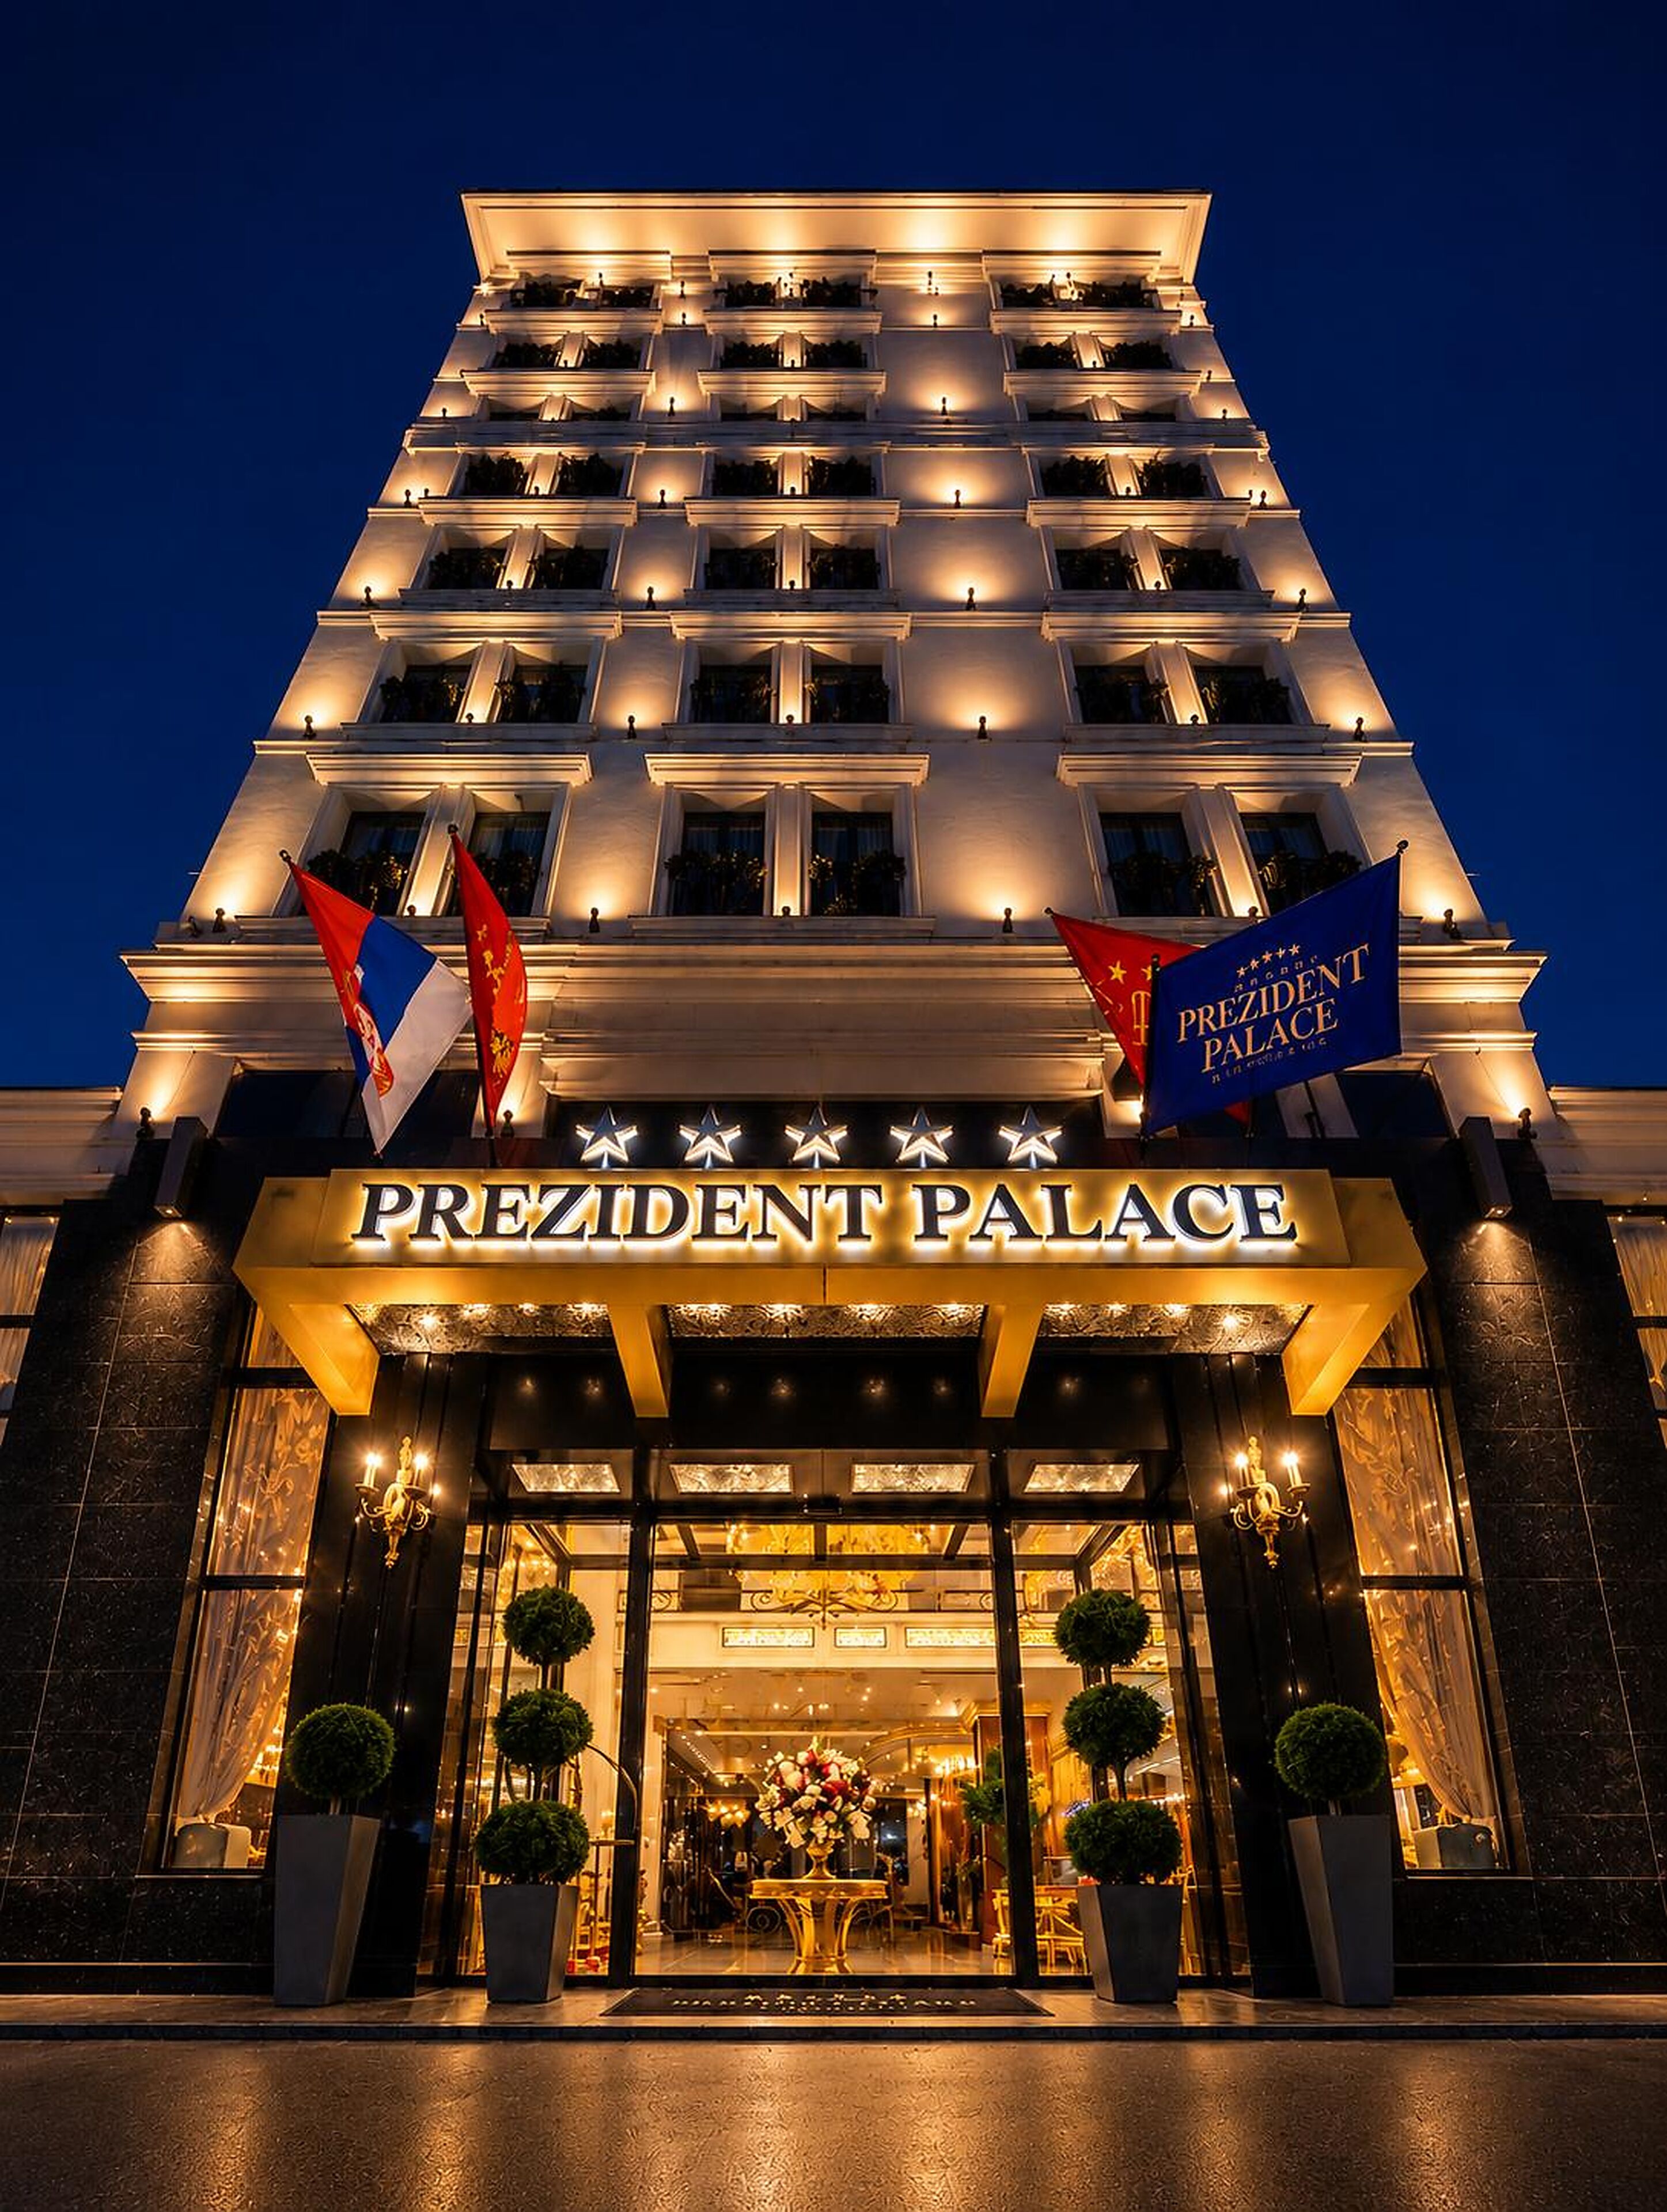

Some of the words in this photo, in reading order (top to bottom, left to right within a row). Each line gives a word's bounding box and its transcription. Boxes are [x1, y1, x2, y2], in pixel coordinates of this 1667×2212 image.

[1177, 943, 1370, 1043] PREZIDENT
[1201, 998, 1339, 1073] PALACE
[351, 1183, 883, 1243] PREZIDENT
[911, 1183, 1298, 1243] PALACE
